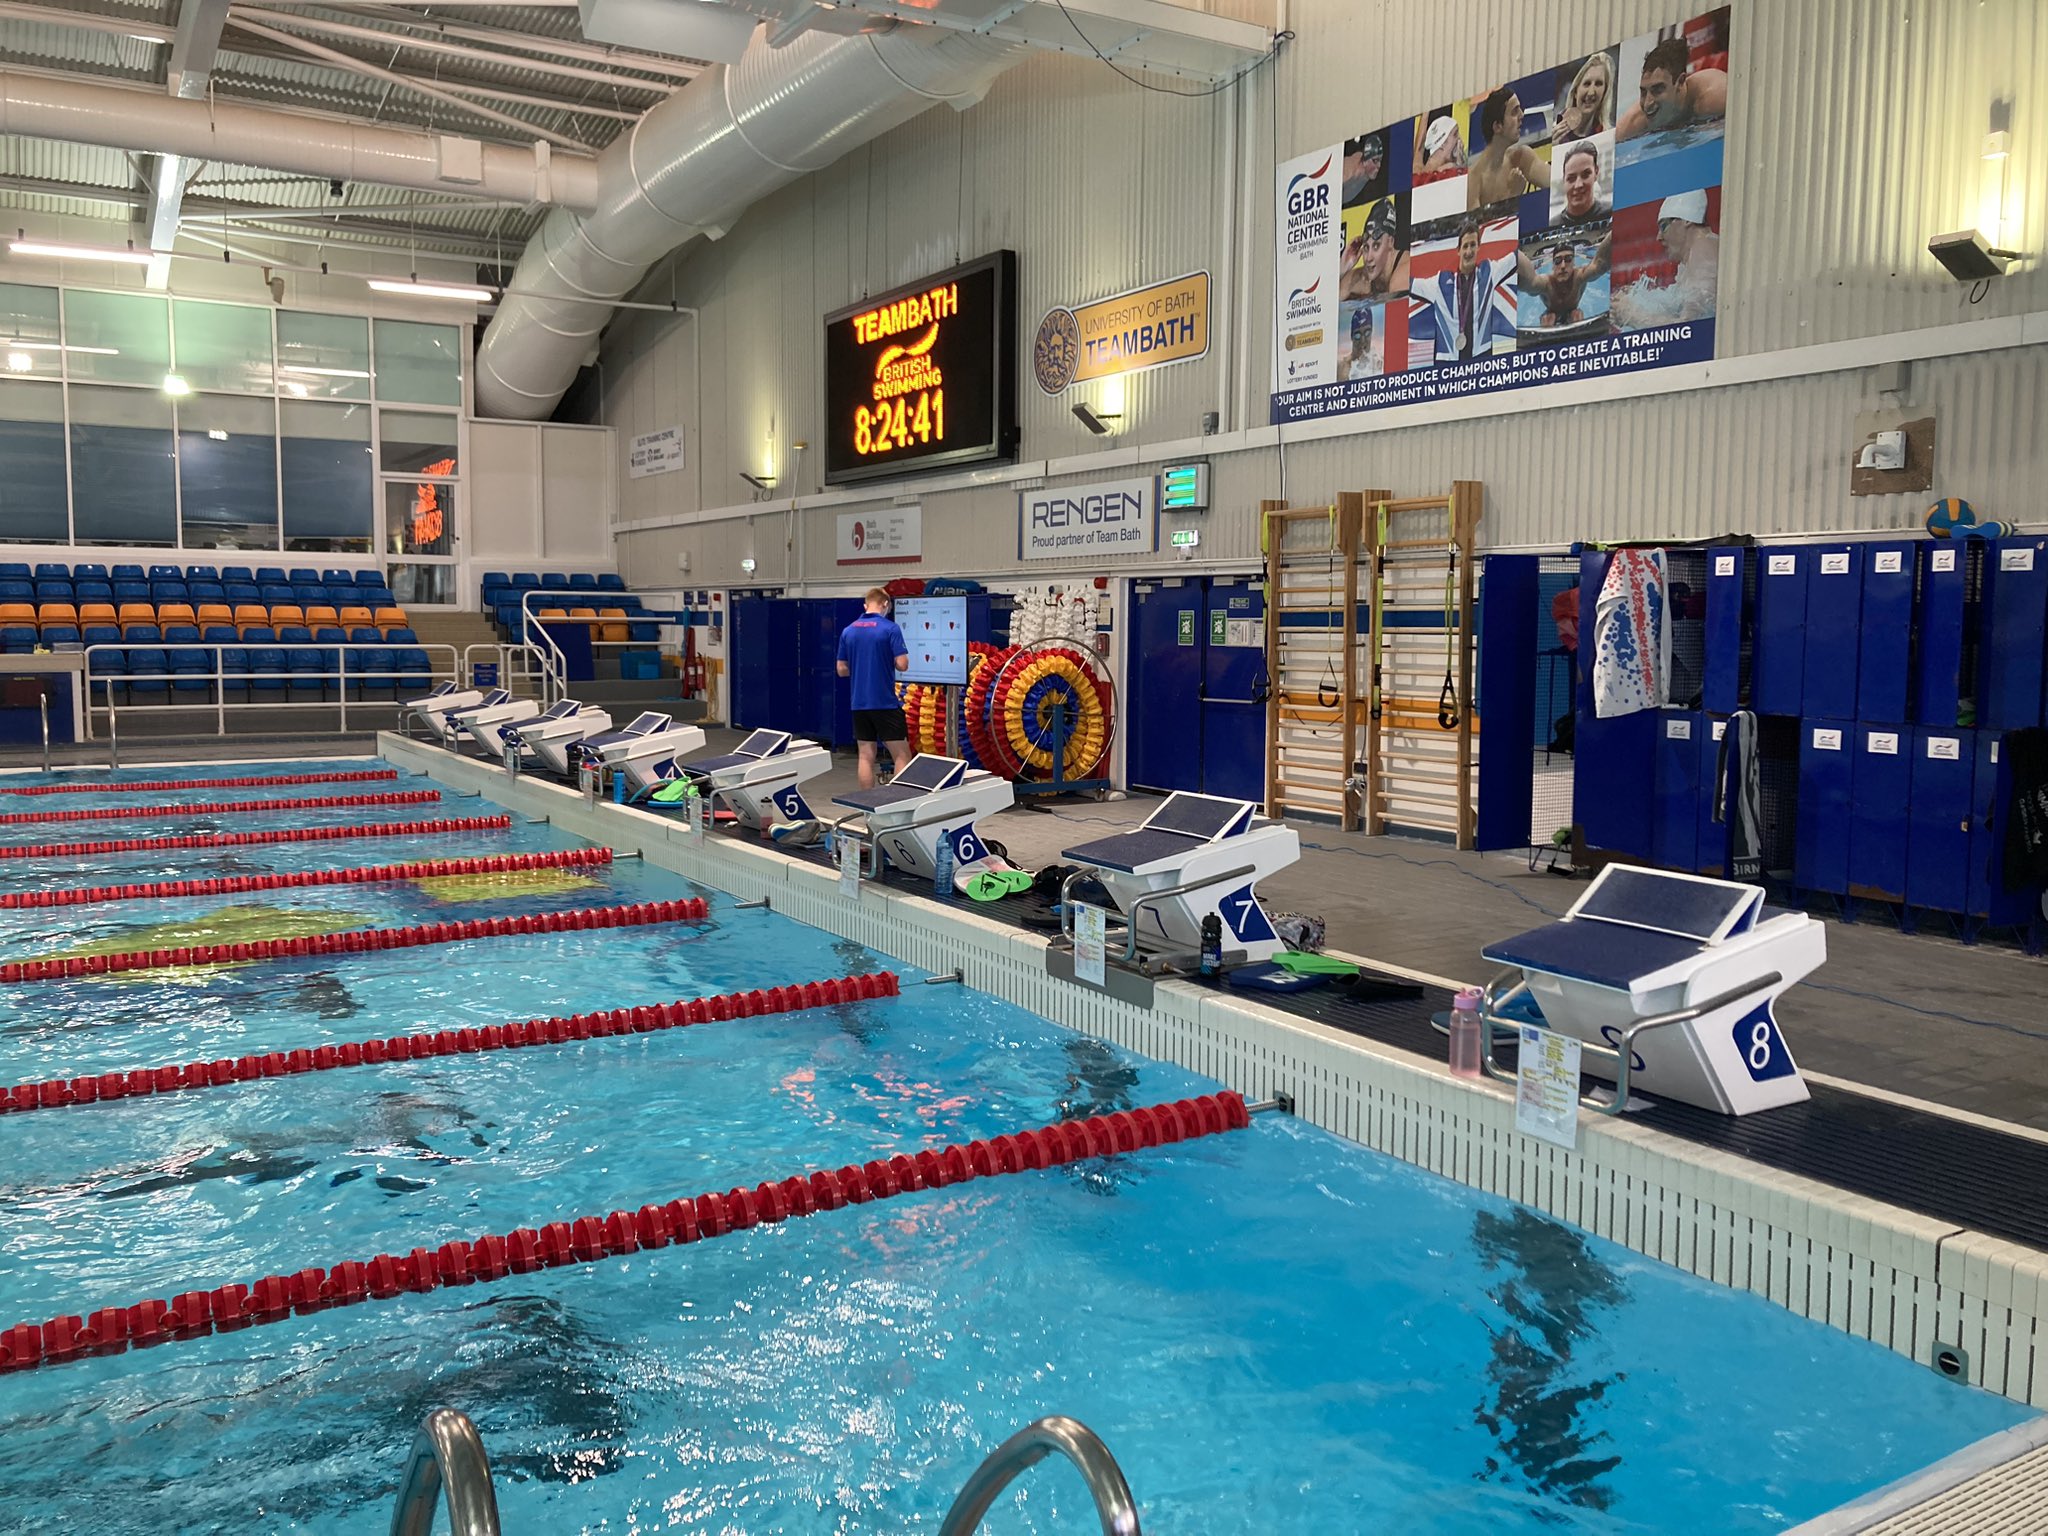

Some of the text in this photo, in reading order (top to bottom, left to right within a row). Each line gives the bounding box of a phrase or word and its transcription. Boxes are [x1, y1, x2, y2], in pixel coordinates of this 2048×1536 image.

[1288, 183, 1329, 216] GBR
[1288, 207, 1329, 230] NATIONAL
[1287, 236, 1329, 255] FOR SWIMMING
[1288, 221, 1329, 245] CENTRE
[1300, 250, 1314, 260] BATH
[853, 282, 958, 344] TEAMBATH
[1086, 290, 1195, 334] UNIVERSITY OF BATH
[1286, 304, 1321, 320] SWIMMING
[1291, 295, 1316, 310] BRITISH
[1086, 313, 1194, 366] TEAMBATH
[883, 354, 932, 382] BRITISH
[1296, 390, 1312, 404] AIM
[1314, 389, 1322, 400] IS
[1324, 385, 1344, 398] NOT
[1347, 381, 1372, 394] JUST
[1373, 378, 1387, 390] TO
[1388, 370, 1439, 389] PRODUCE
[1441, 358, 1510, 381] CHAMPIONS,
[1512, 352, 1536, 368] BUT
[1539, 349, 1557, 363] TO
[1559, 338, 1608, 360] CREATE
[1611, 337, 1621, 350] A
[1623, 326, 1692, 348] TRAINING
[1305, 360, 1318, 369] sport
[873, 367, 942, 400] SWIMMING
[1289, 403, 1324, 417] CENTRE
[1326, 398, 1347, 412] AND
[1350, 387, 1421, 408] ENVIRONMENT
[1424, 384, 1436, 396] IN
[1438, 378, 1480, 395] WHICH
[1481, 366, 1549, 388] CHAMPIONS
[1551, 361, 1577, 377] ARE
[1303, 374, 1318, 382] FUNDED
[854, 388, 943, 454] 8:24:41
[1033, 490, 1142, 529] RENGEN
[866, 530, 885, 540] Building
[866, 543, 881, 552] Society
[1032, 527, 1141, 549] Proud partner of Team Bath
[664, 766, 676, 780] 4
[785, 794, 799, 816] 5
[958, 834, 974, 860] 6
[1235, 900, 1253, 934] 7
[1750, 1021, 1770, 1070] 8
